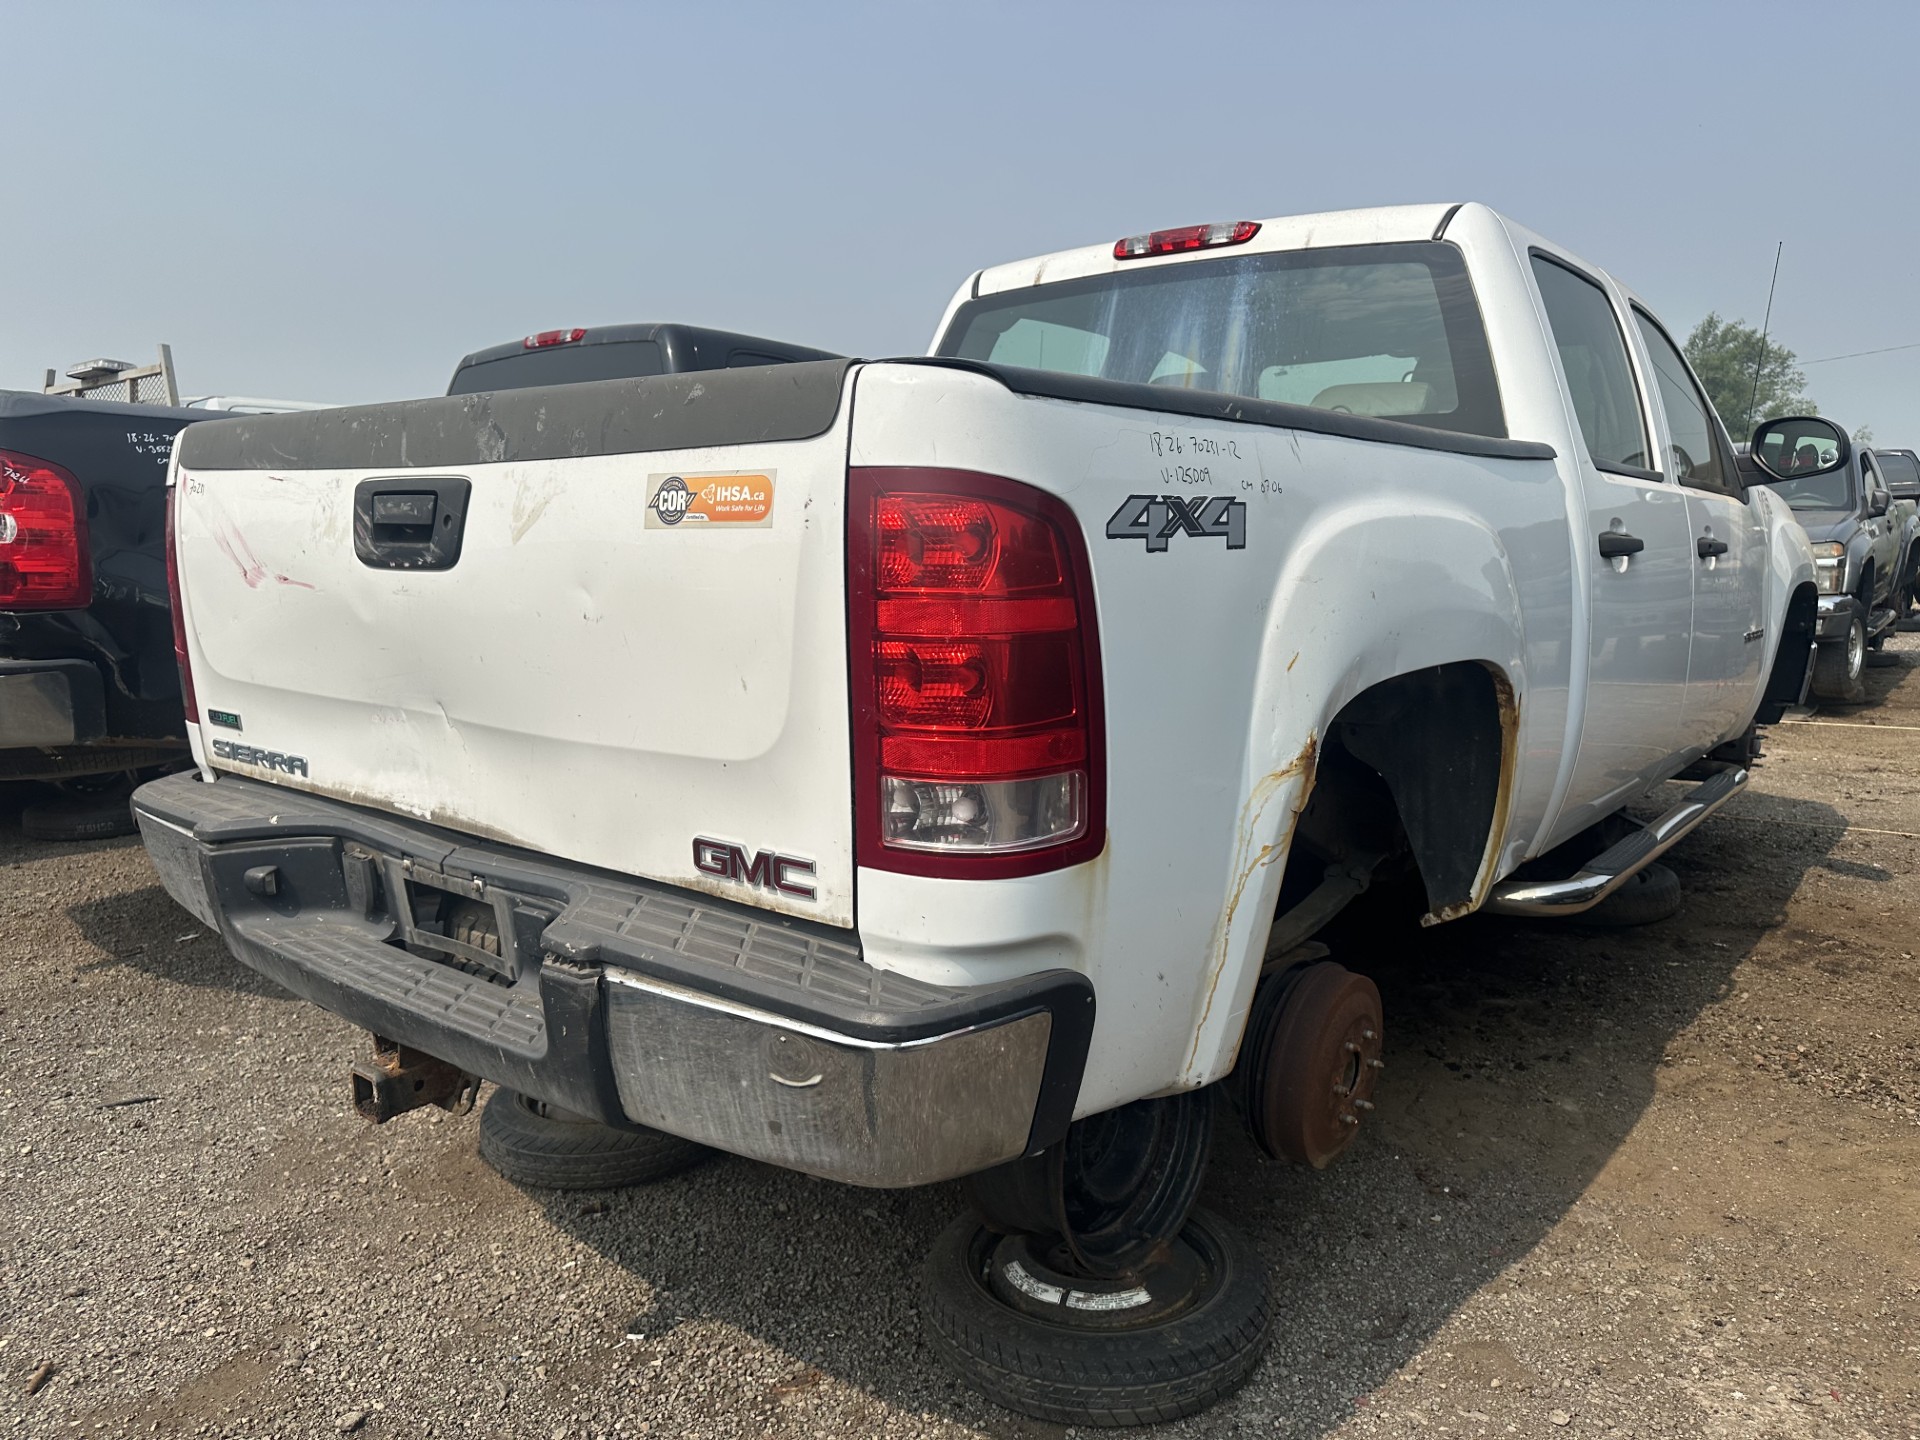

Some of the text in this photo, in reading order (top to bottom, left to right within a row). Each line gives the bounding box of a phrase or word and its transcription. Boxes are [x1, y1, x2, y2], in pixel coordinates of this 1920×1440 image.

[659, 490, 687, 511] COR
[716, 485, 765, 502] IHSA.ca
[212, 738, 309, 779] SIERRA
[692, 835, 818, 901] GMC
